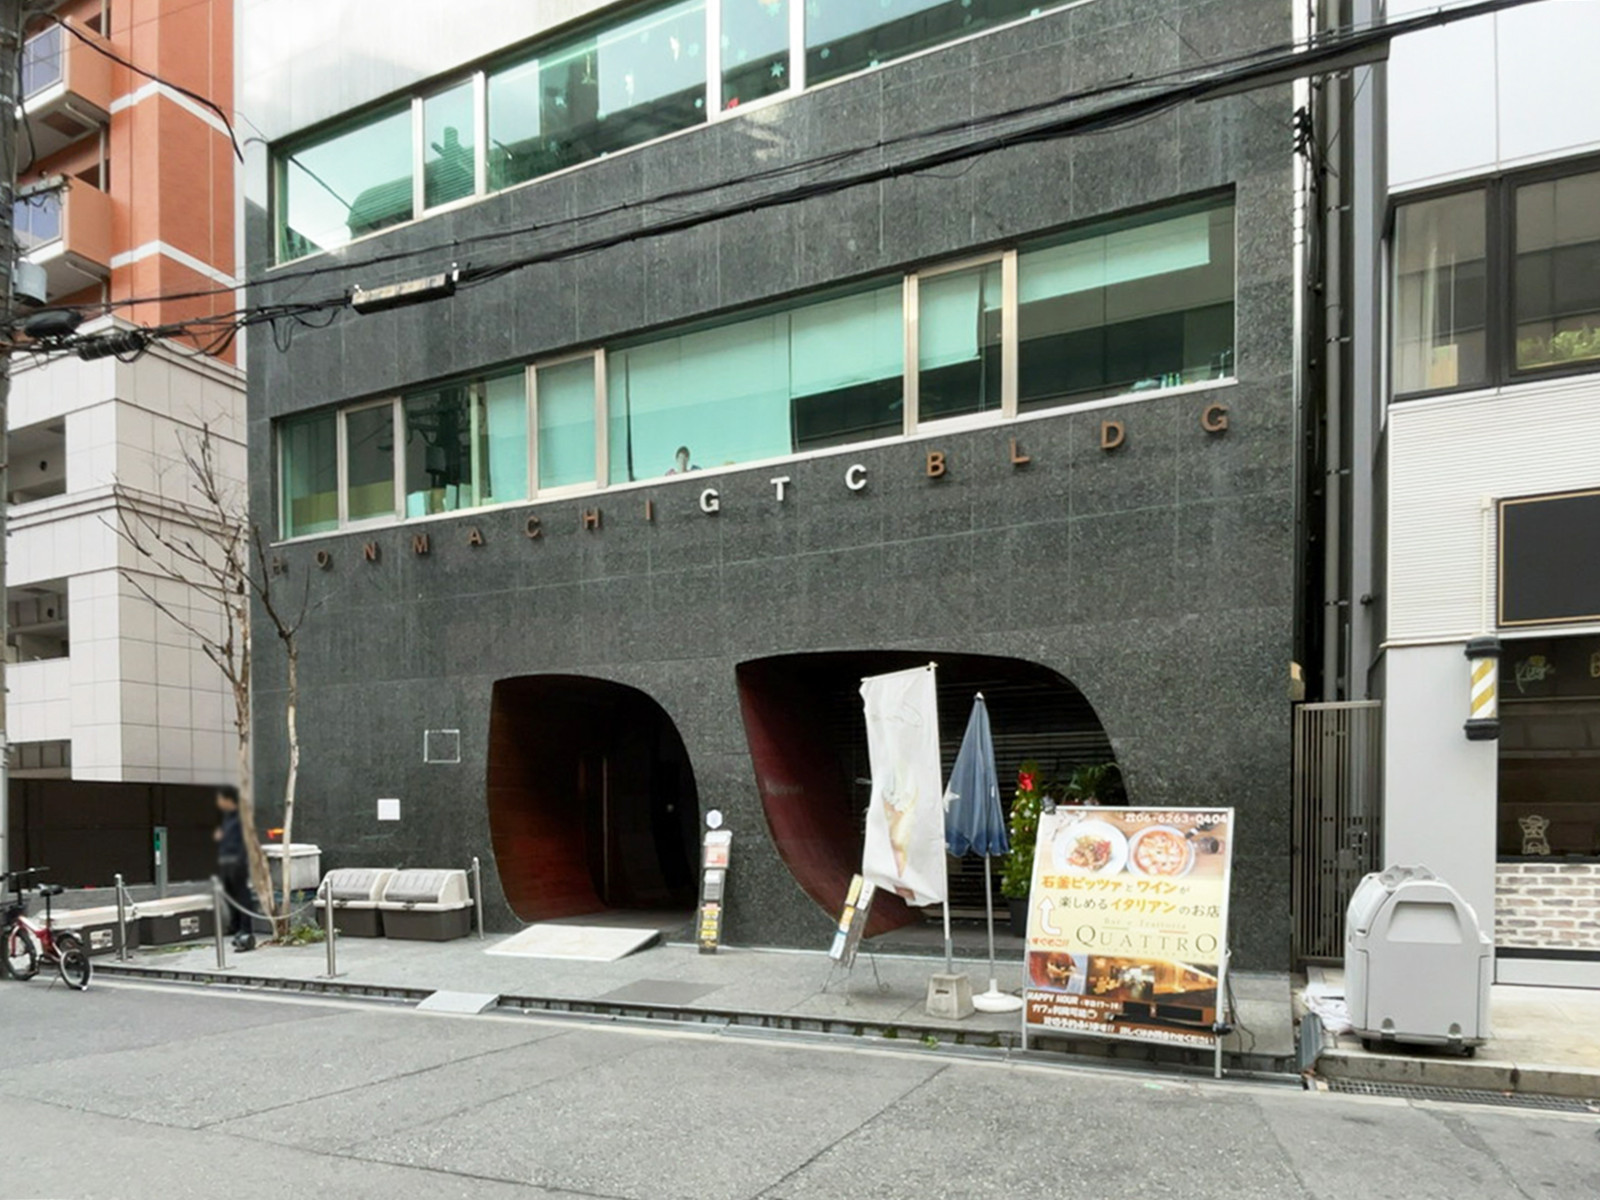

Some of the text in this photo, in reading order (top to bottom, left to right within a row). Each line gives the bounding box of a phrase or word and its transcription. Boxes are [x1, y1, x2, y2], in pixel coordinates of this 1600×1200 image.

[272, 403, 1229, 574] HONMACHI GTC BLDG
[1076, 924, 1218, 954] QUATTRO
